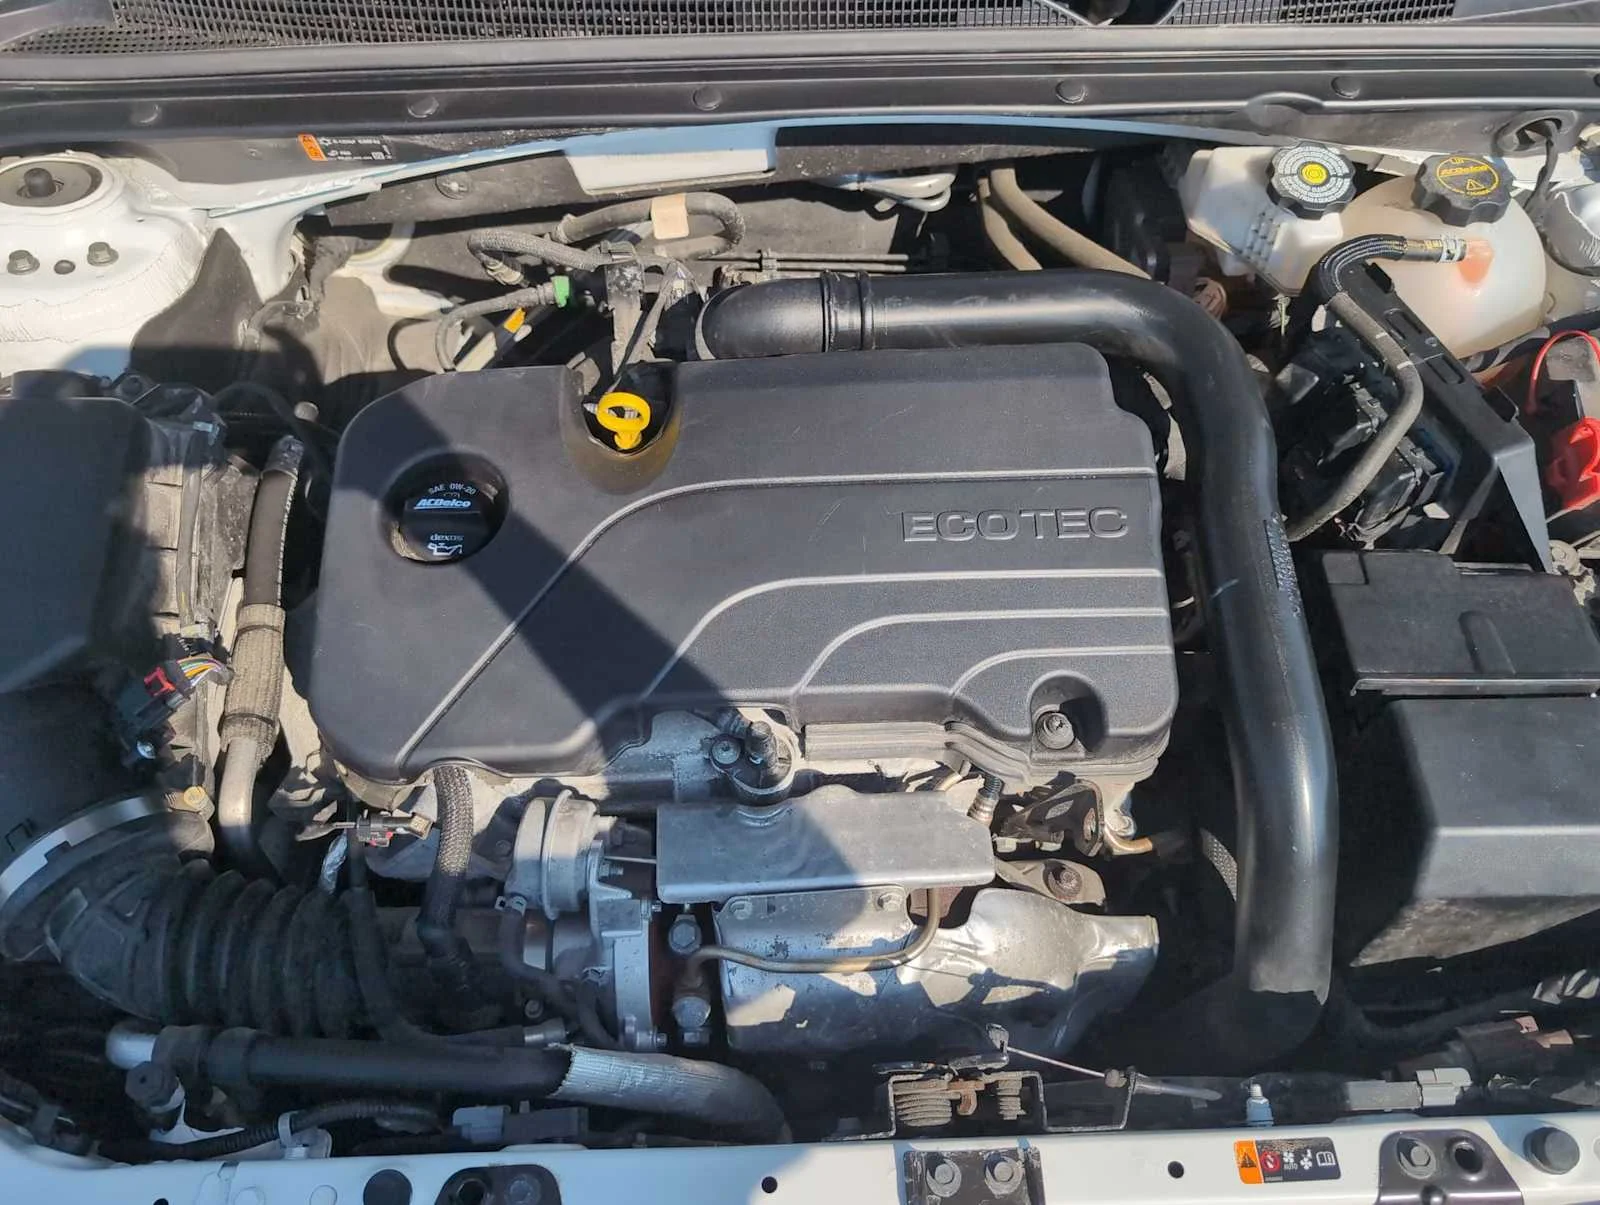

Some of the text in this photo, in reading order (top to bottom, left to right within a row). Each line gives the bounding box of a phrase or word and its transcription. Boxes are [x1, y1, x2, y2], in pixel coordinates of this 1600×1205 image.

[428, 482, 477, 495] SAE 0W-20
[414, 498, 472, 509] ACDelco
[901, 506, 1129, 542] ECOTEC
[430, 533, 464, 541] dexos
